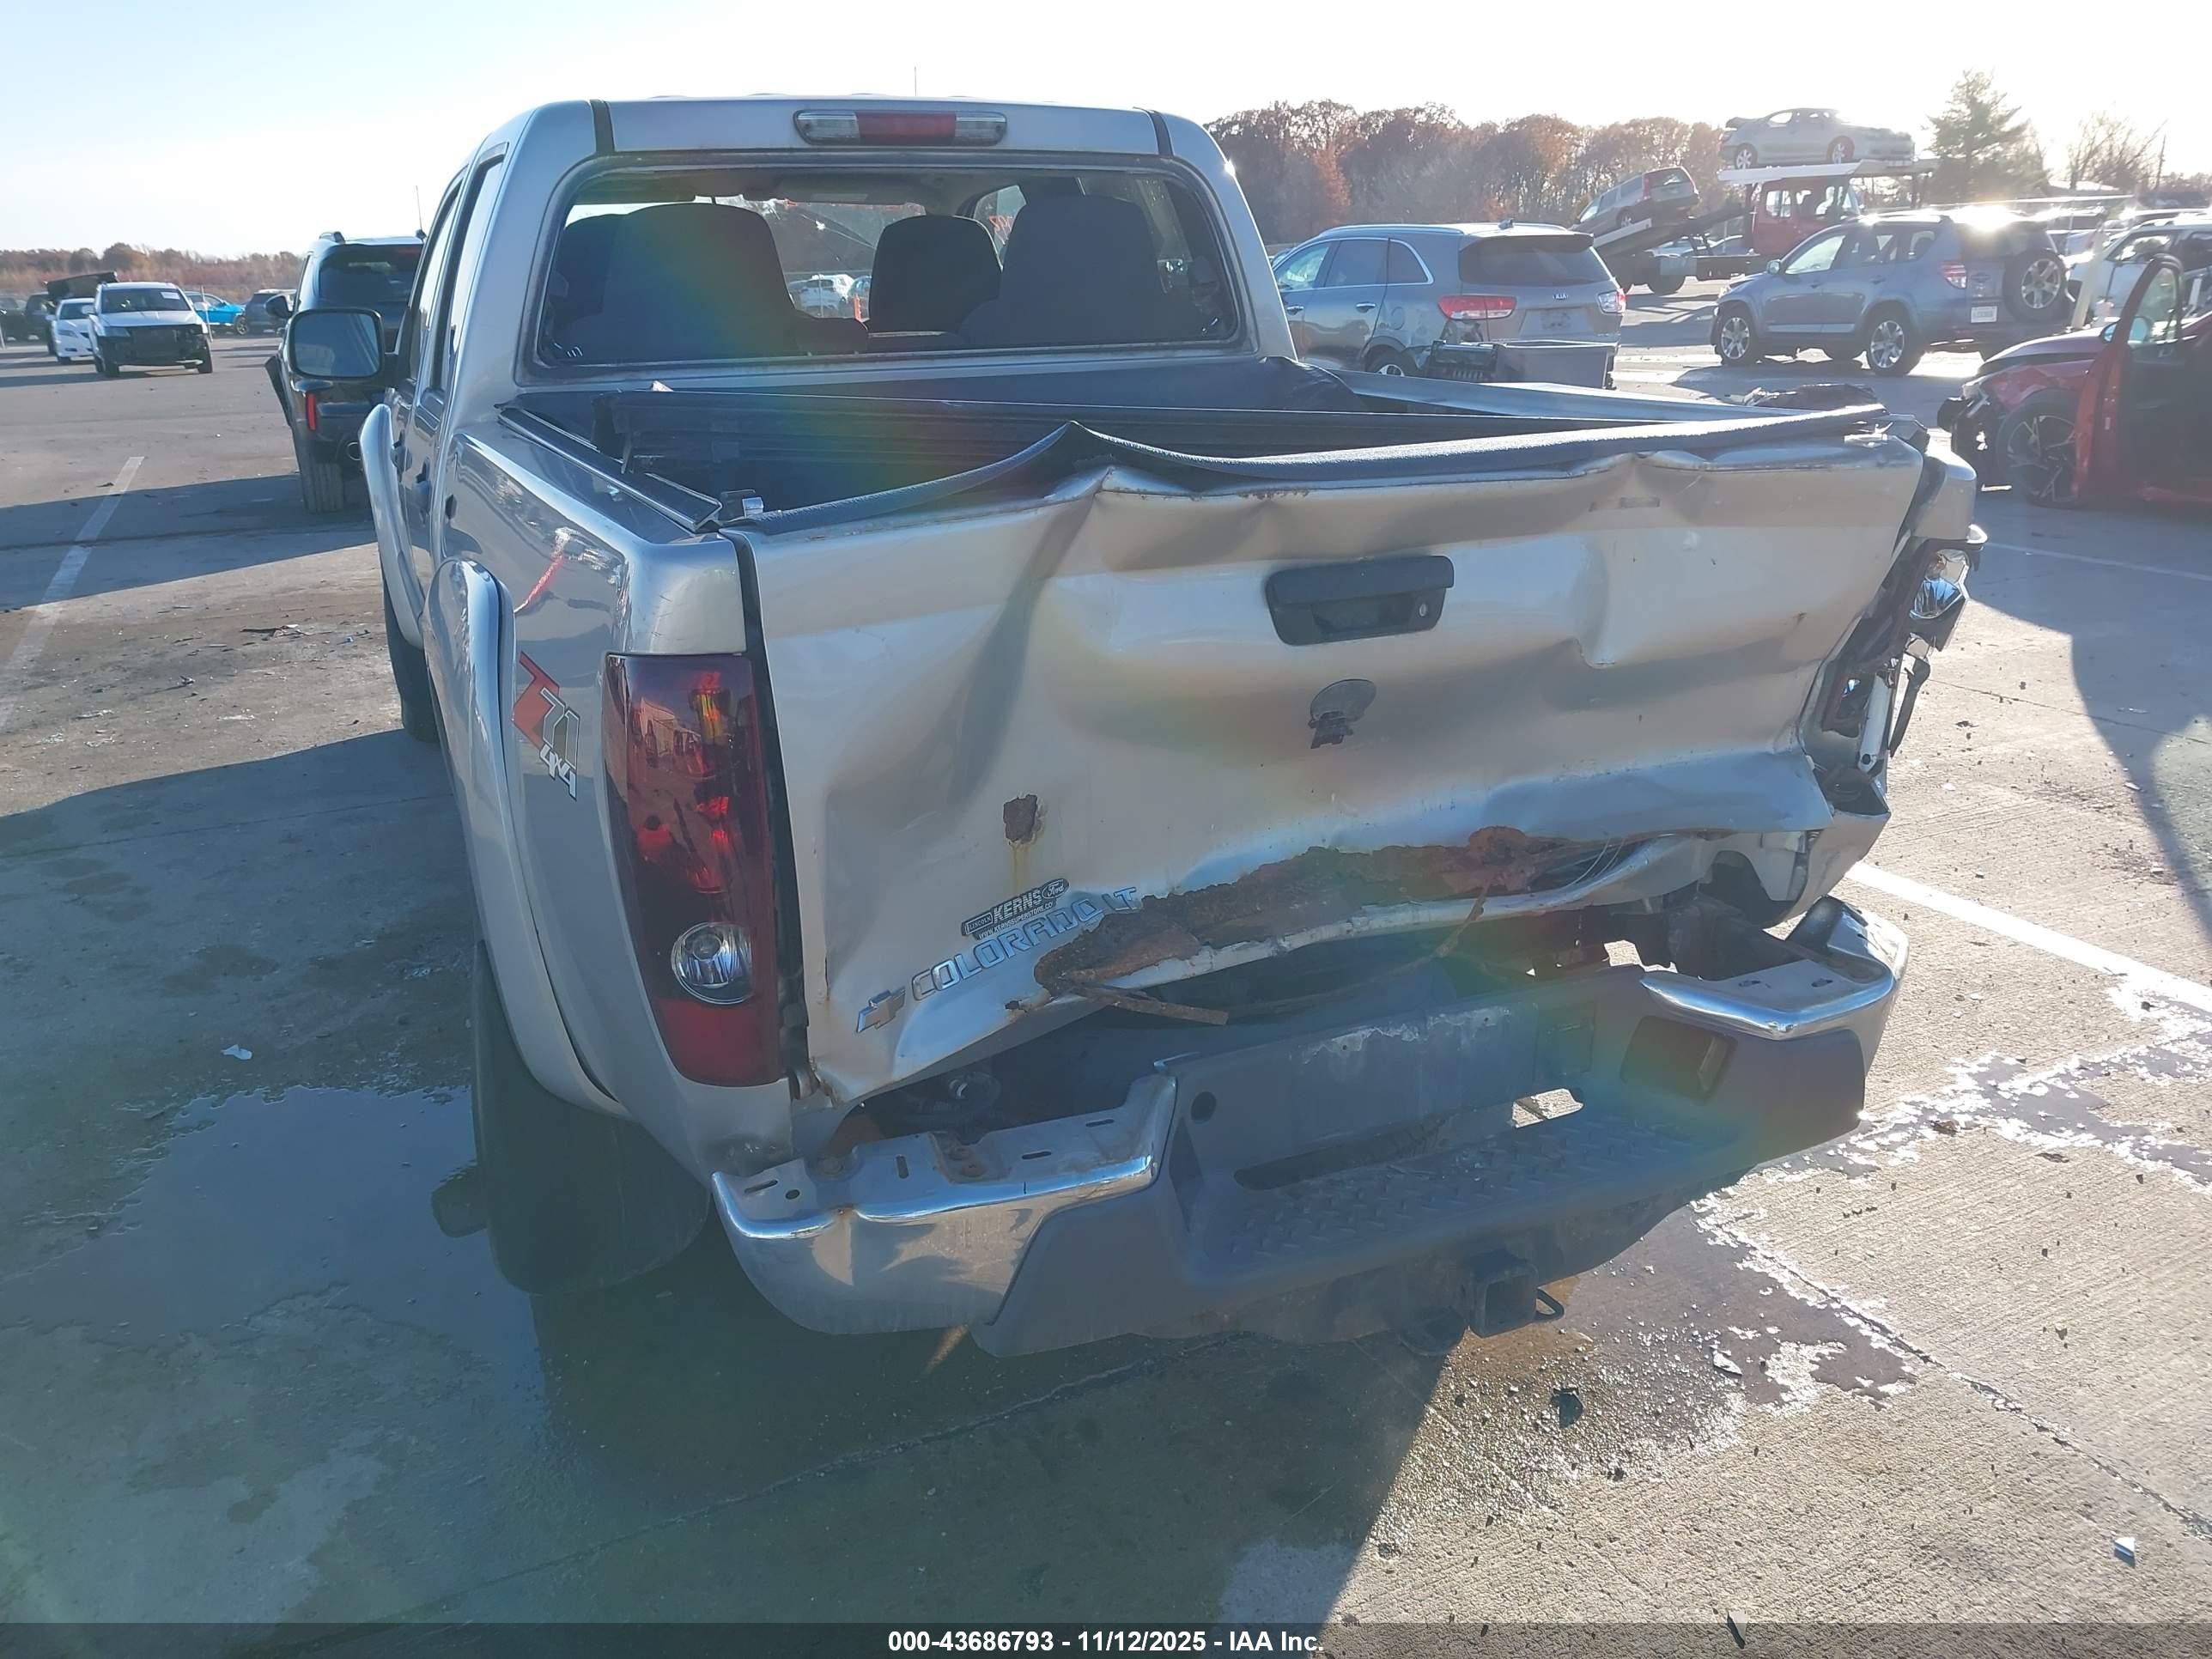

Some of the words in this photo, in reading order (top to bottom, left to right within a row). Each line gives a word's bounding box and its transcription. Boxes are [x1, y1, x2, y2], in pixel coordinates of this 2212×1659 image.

[969, 915, 991, 931] LINCOLN
[993, 888, 1042, 925] KERNS
[911, 898, 1104, 1002] COLORADO
